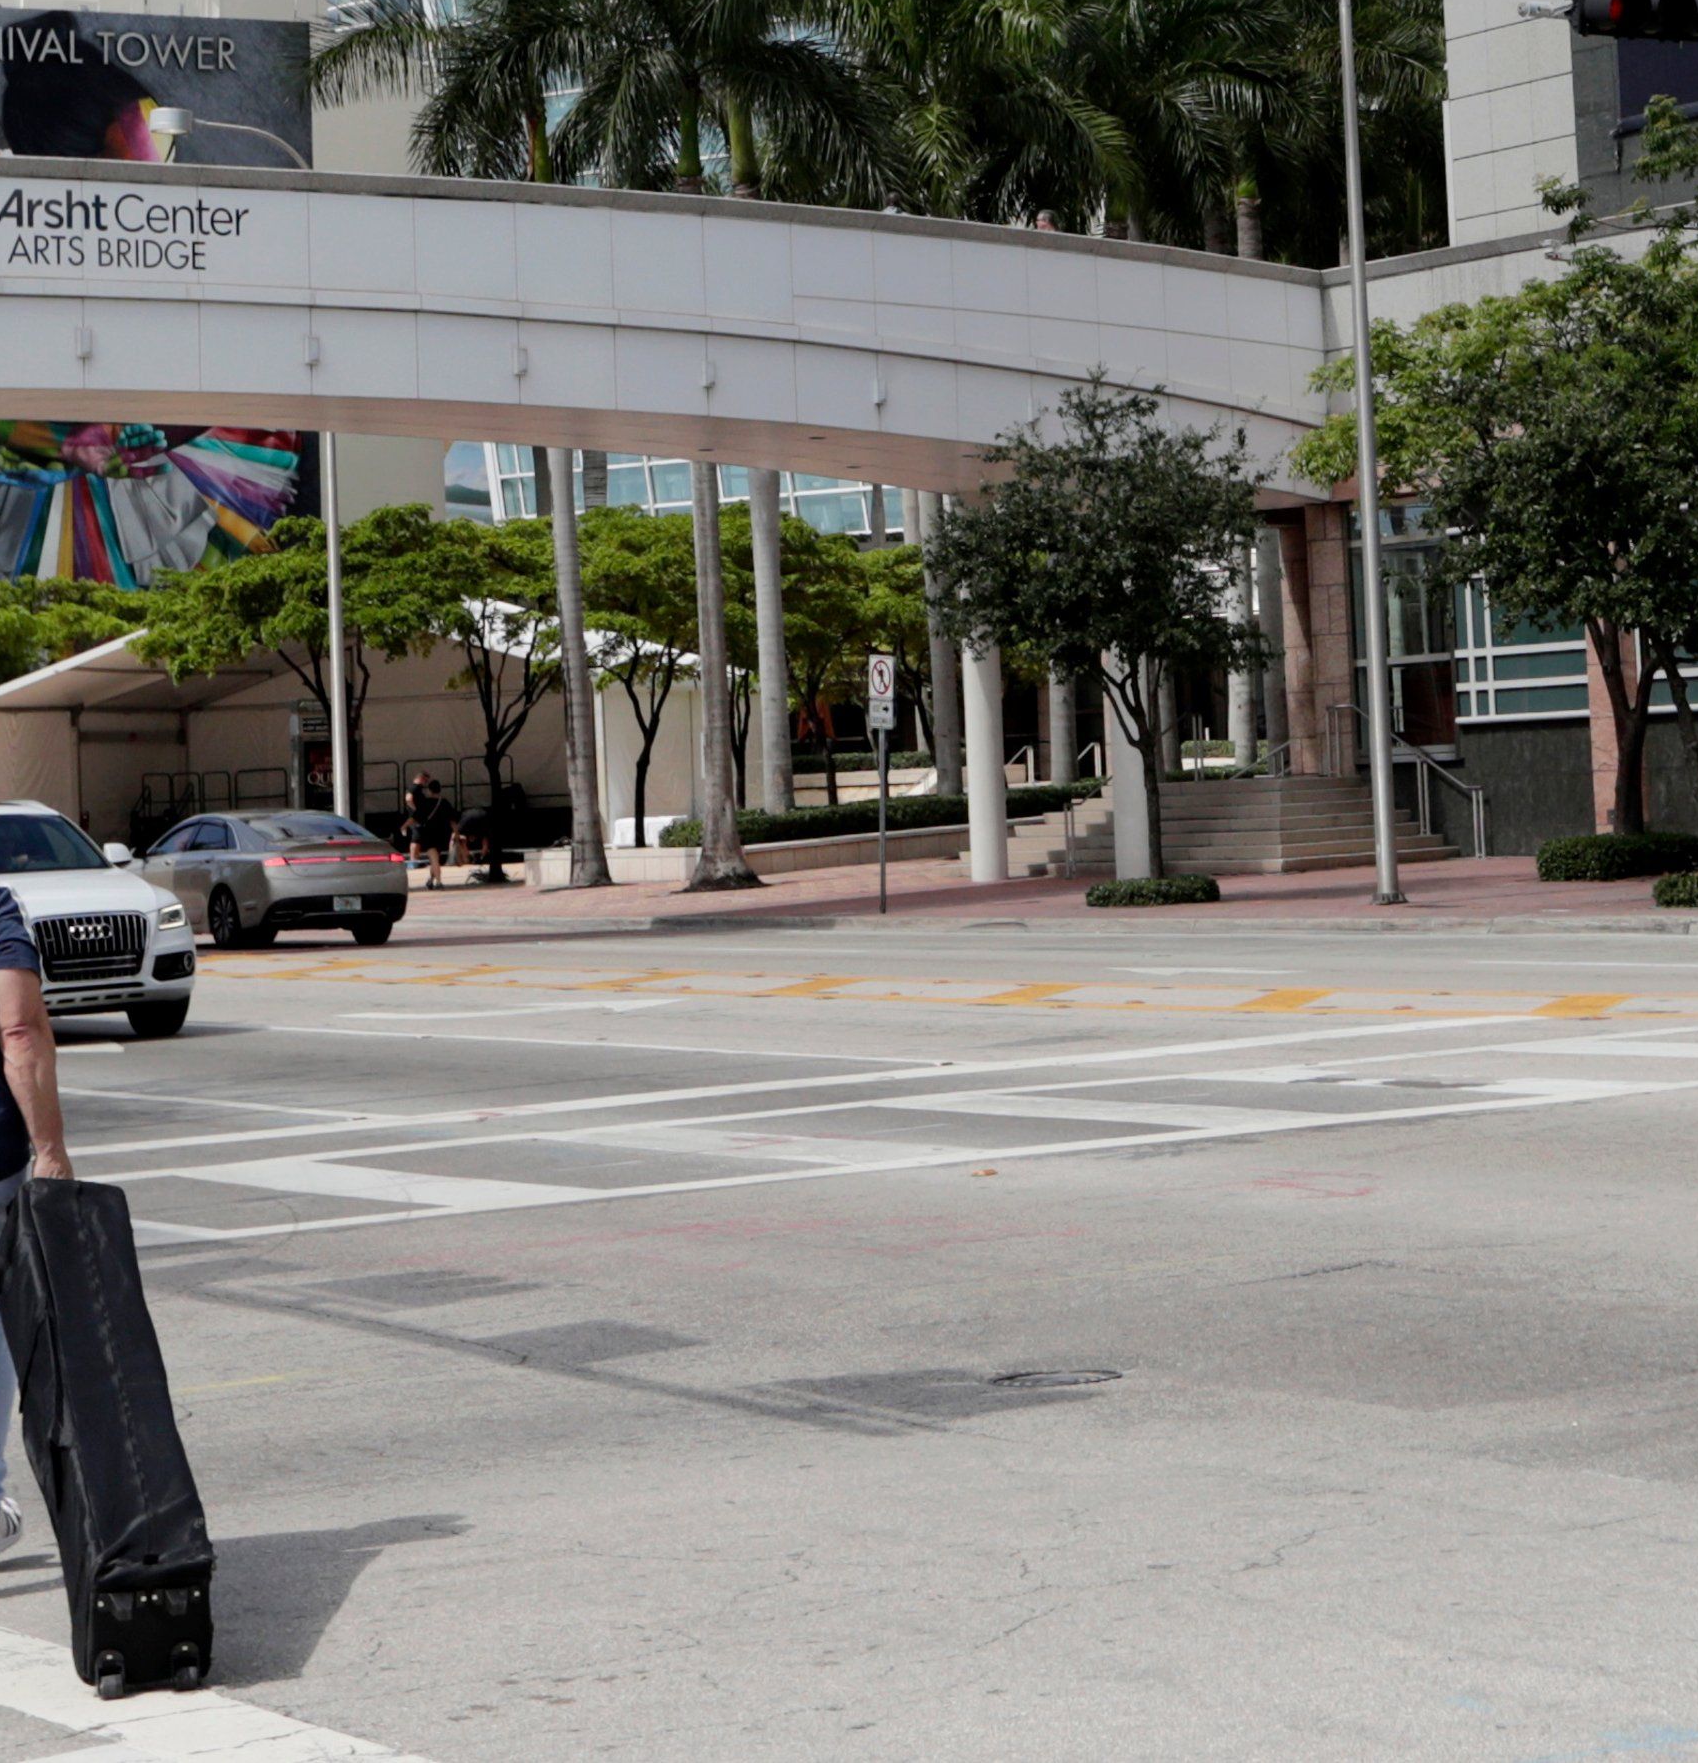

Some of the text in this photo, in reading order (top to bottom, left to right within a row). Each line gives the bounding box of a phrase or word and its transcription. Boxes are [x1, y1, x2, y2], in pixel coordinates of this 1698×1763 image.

[96, 31, 236, 71] TOWER
[114, 193, 250, 236] Center
[8, 234, 85, 266] ARTS
[98, 237, 207, 270] BRIDGE
